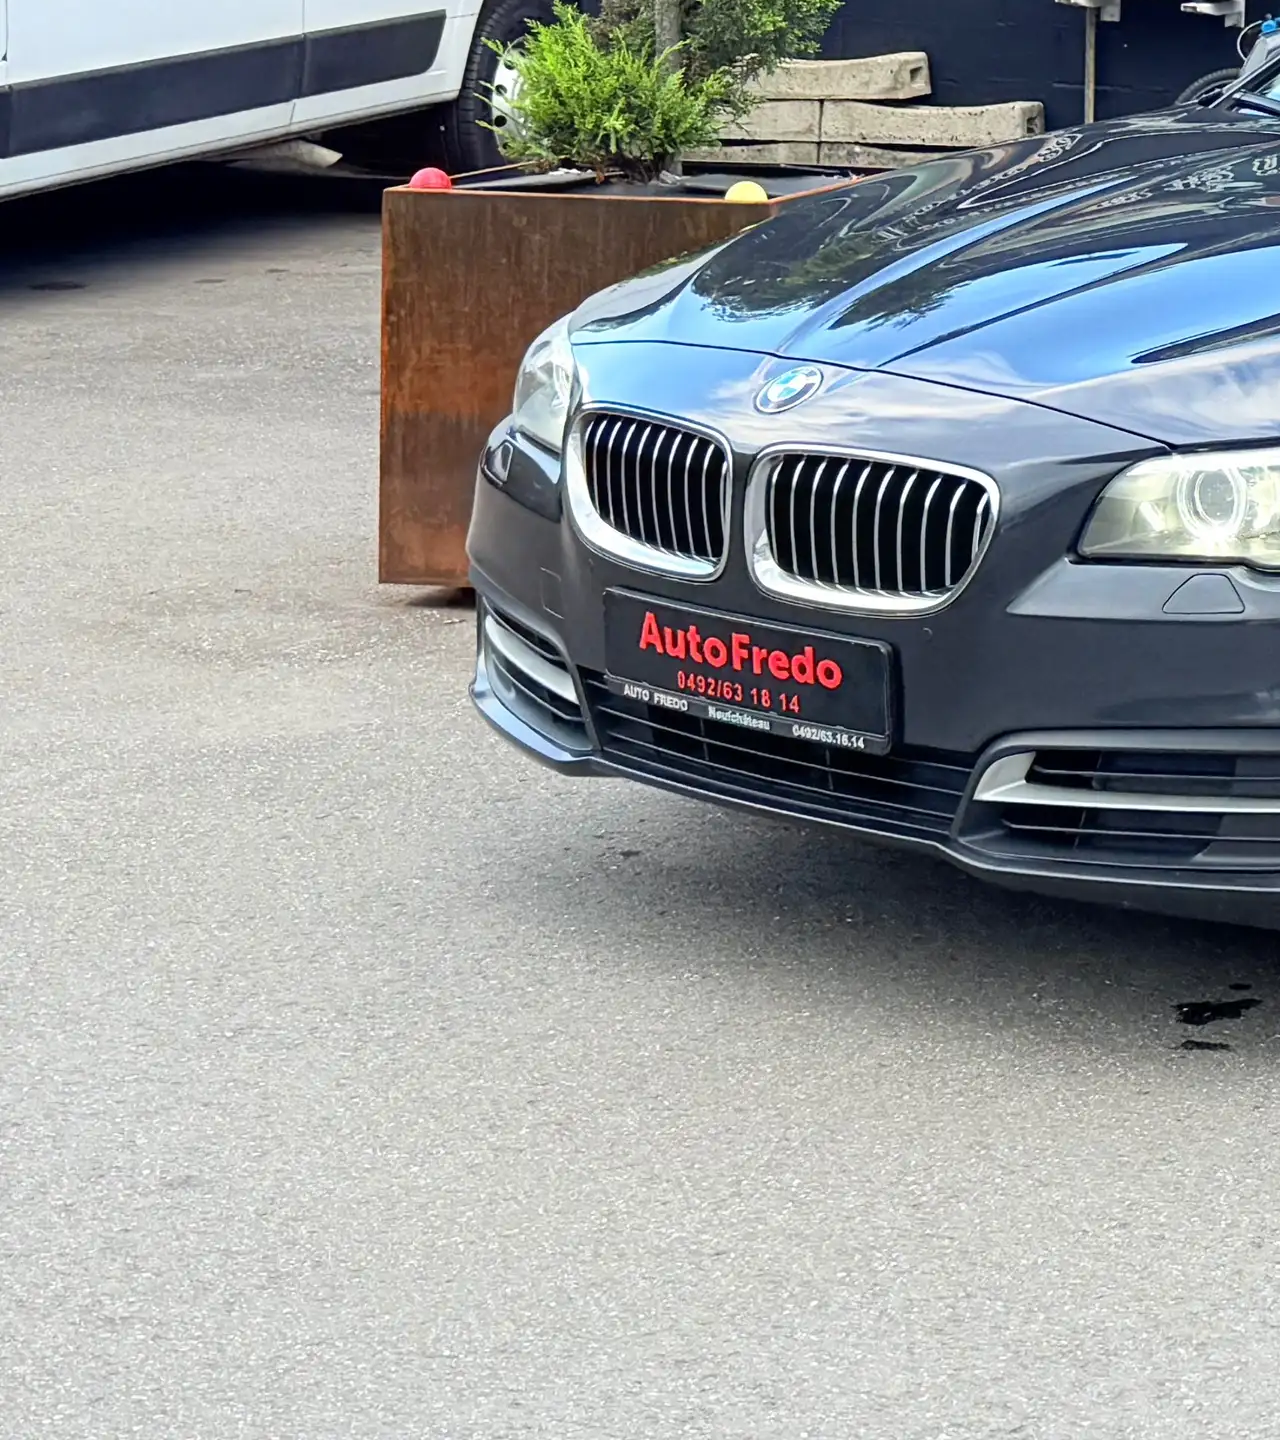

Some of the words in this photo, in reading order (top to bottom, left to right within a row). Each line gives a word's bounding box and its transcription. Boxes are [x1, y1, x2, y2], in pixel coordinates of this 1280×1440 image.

[638, 611, 843, 690] AutoFredo
[623, 683, 650, 701] AUTO
[653, 692, 689, 712] FREDO
[677, 670, 744, 702] 0492/63
[751, 687, 772, 708] 18
[779, 692, 801, 713] 14
